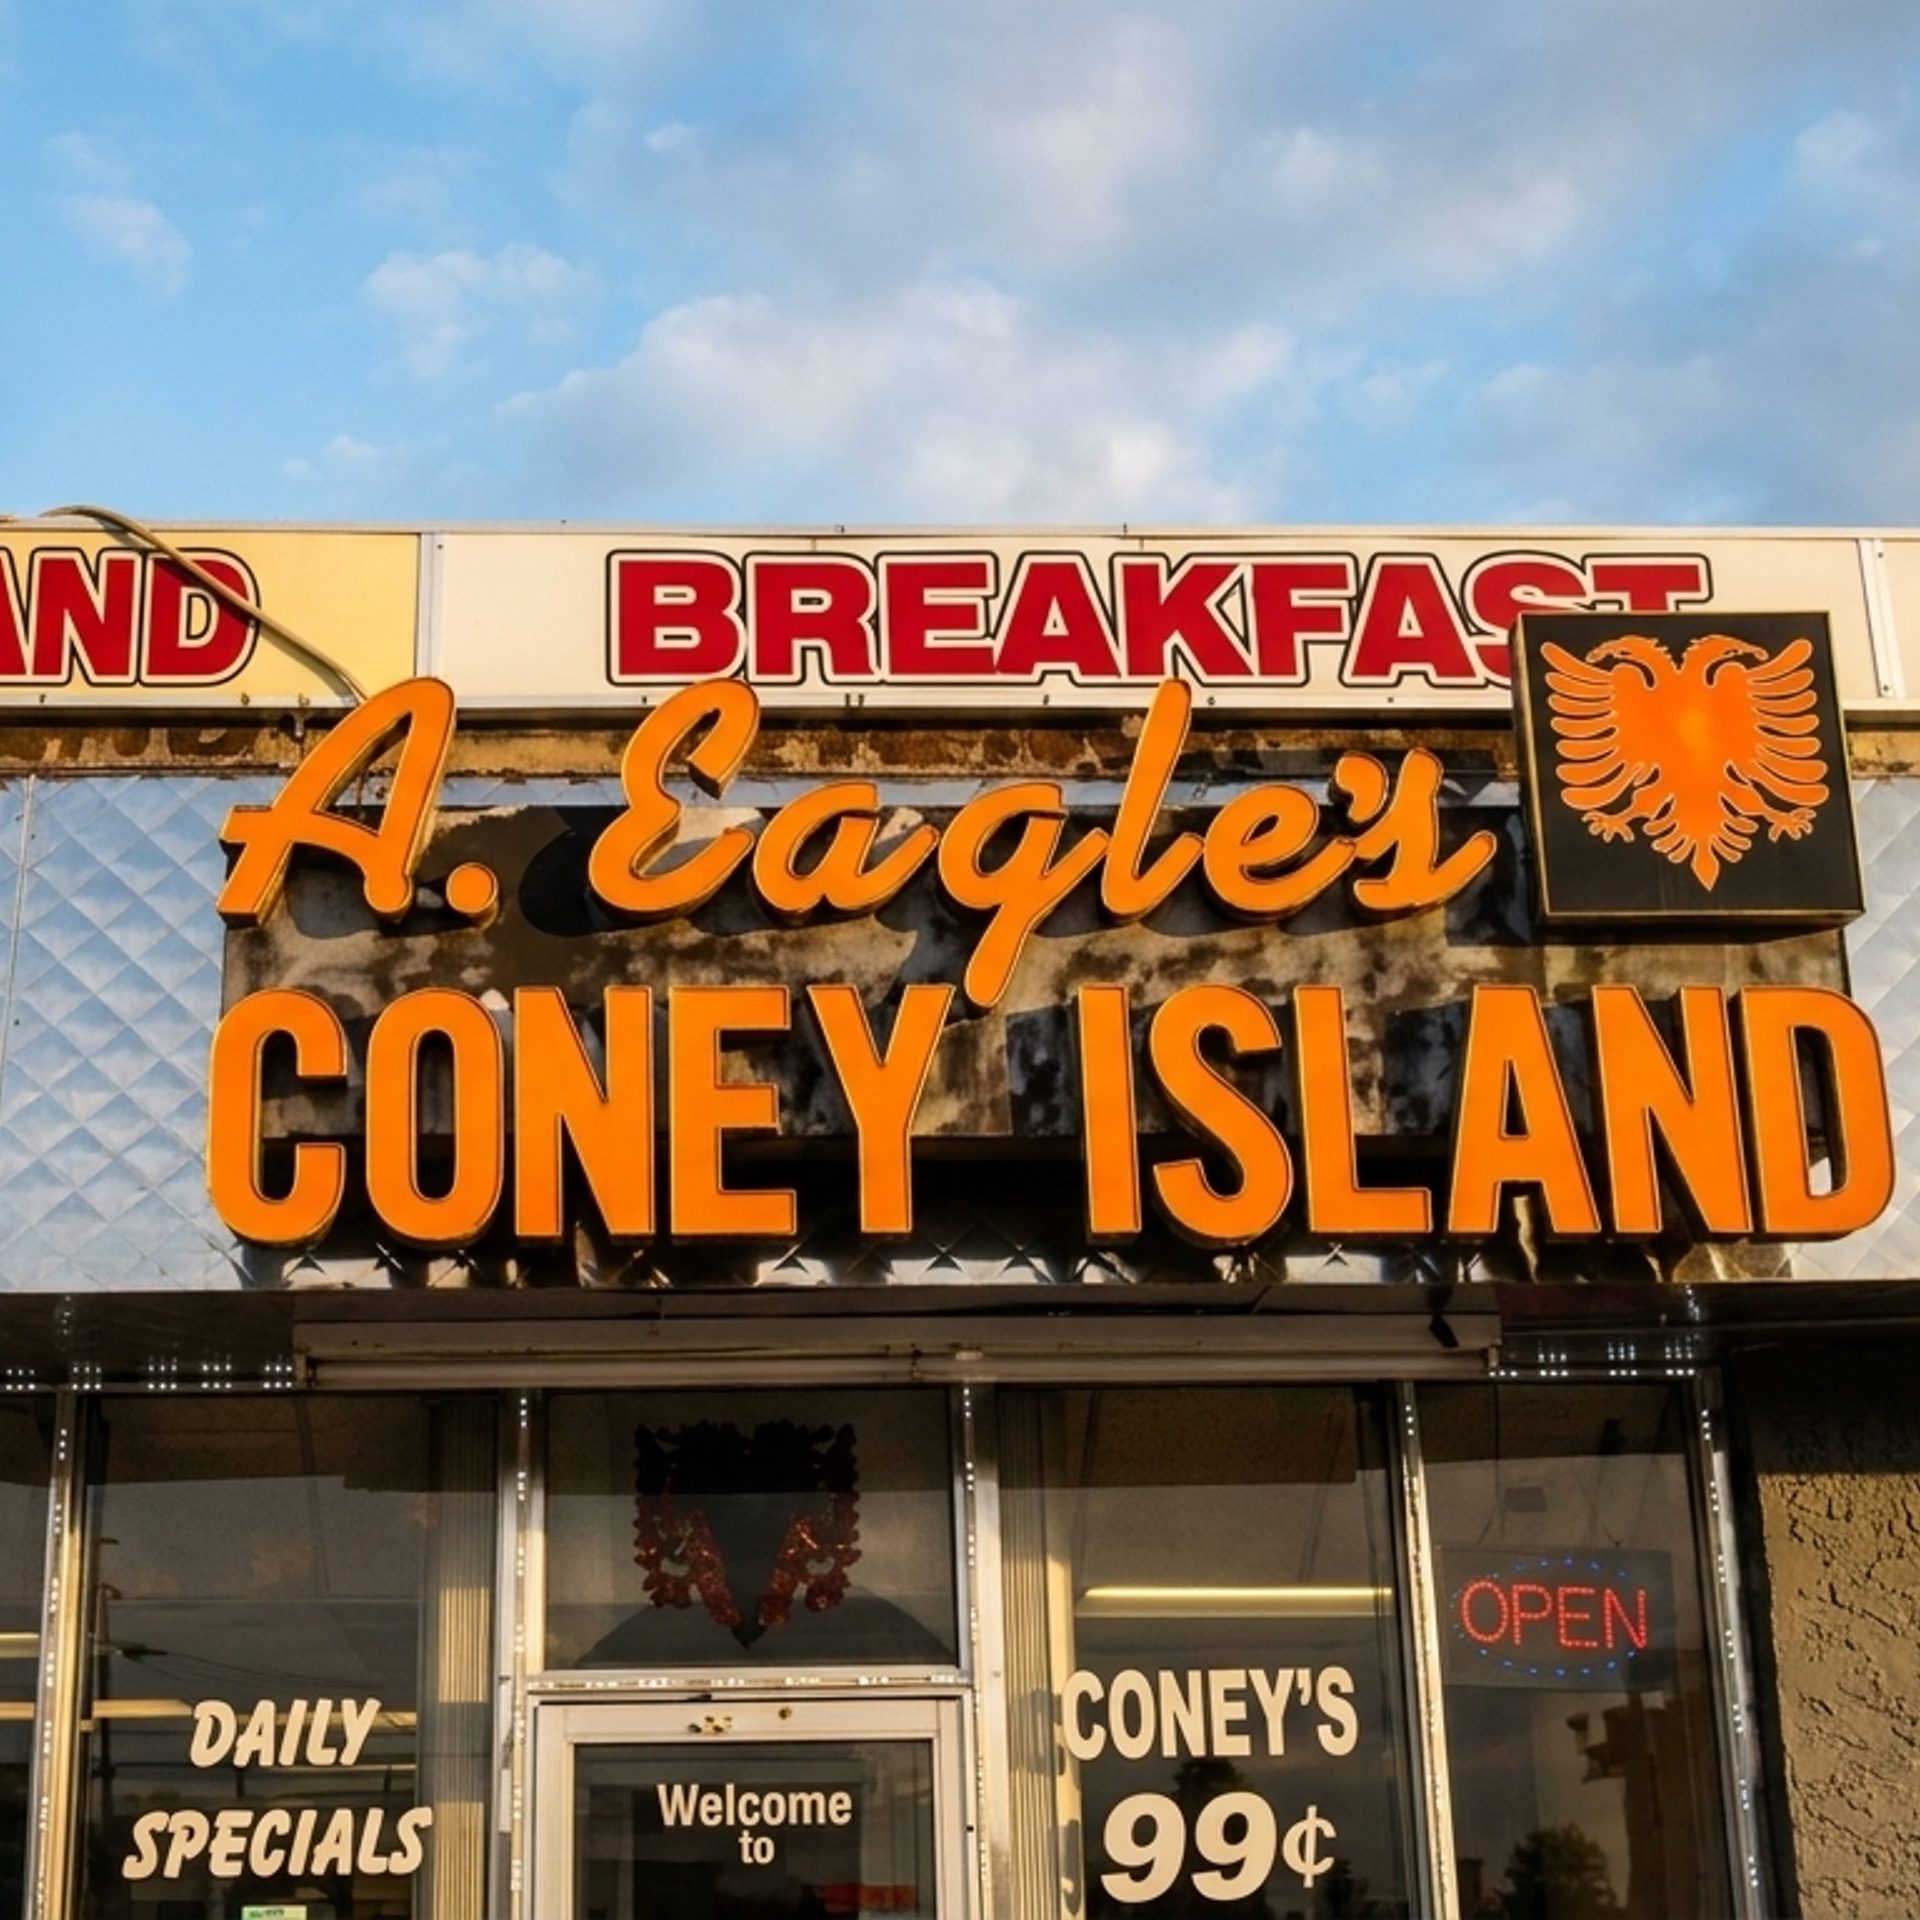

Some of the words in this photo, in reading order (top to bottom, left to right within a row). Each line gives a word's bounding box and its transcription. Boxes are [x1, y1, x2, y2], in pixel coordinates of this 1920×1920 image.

[217, 677, 501, 925] A.
[587, 677, 1498, 1010] Eagle's
[208, 984, 956, 1244] CONEY
[1077, 984, 1897, 1246] ISLAND
[1459, 1578, 1650, 1651] OPEN
[188, 1697, 382, 1768] DAILY
[1060, 1665, 1360, 1762] CONEY'S
[121, 1805, 434, 1880] SPECIALS
[656, 1783, 853, 1827] Welcome
[737, 1832, 776, 1866] to
[1099, 1791, 1338, 1904] 99¢
